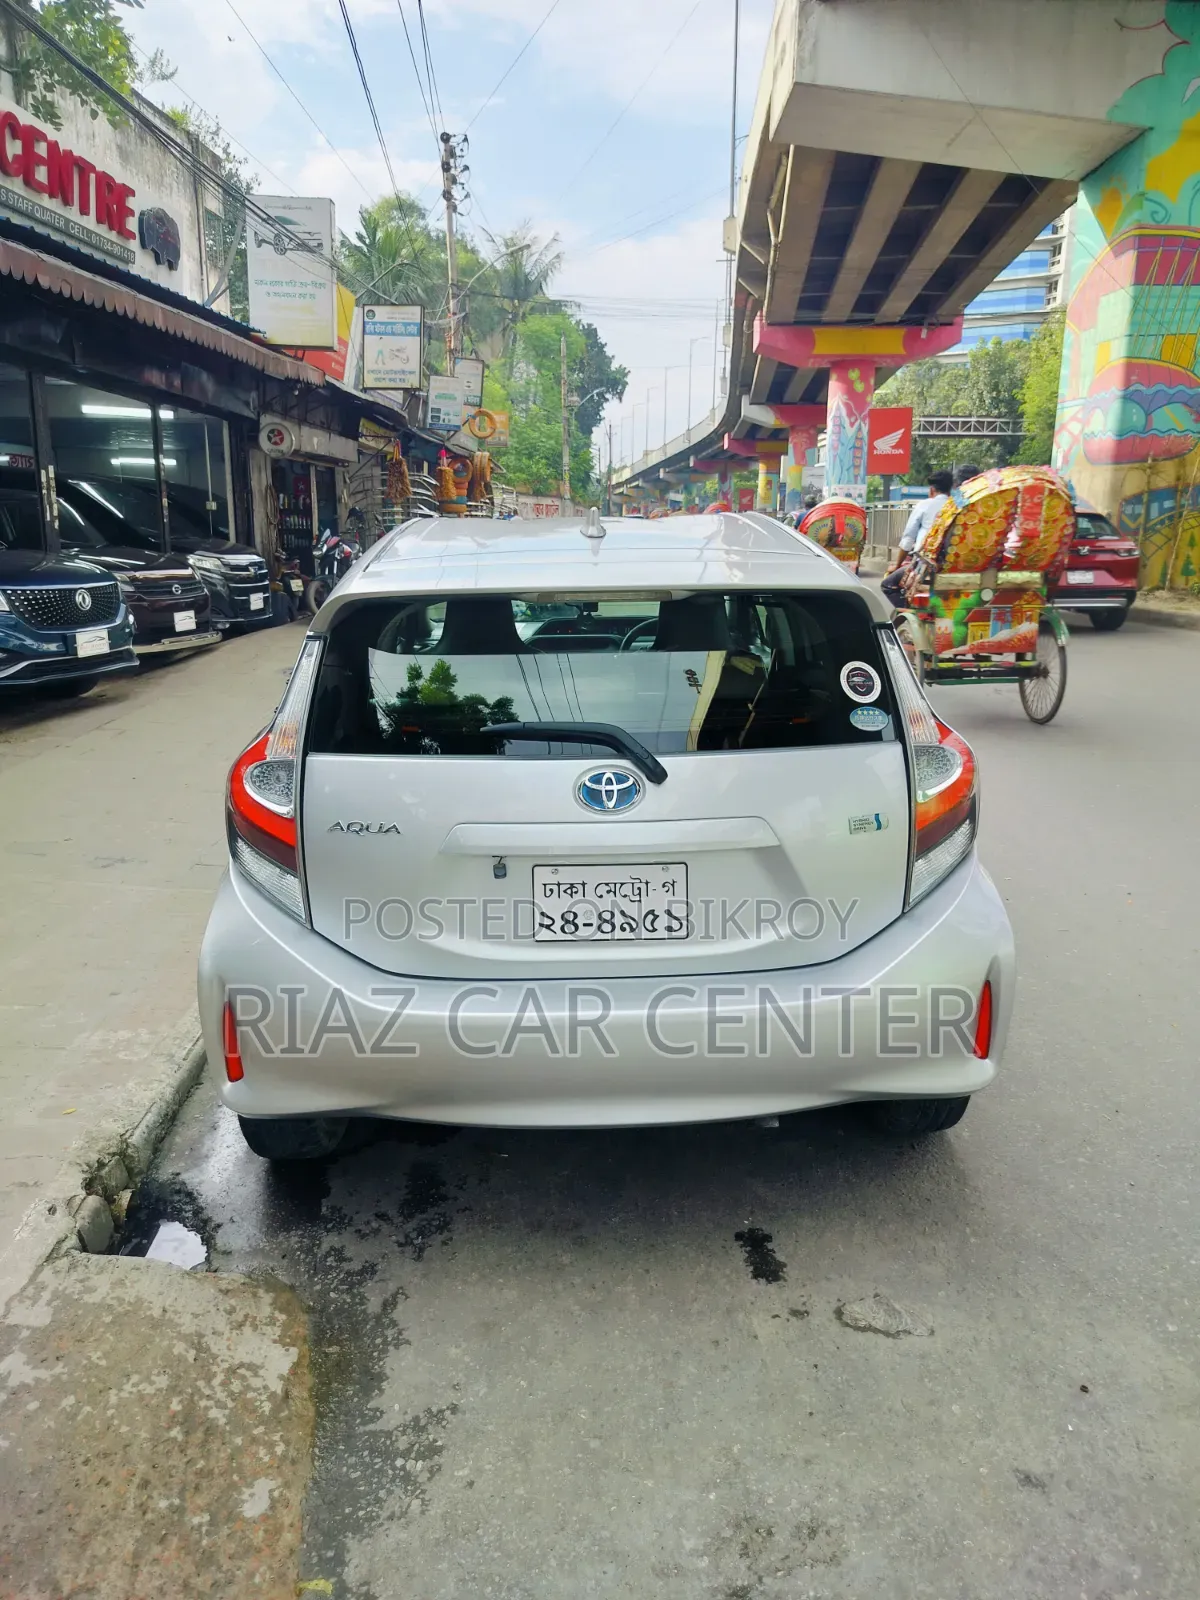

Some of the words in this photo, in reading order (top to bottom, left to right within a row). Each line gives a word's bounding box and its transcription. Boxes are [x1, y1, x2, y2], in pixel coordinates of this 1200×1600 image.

[0, 110, 137, 241] CENTRE
[8, 191, 33, 213] STAFF
[34, 205, 65, 230] QUATER
[69, 222, 91, 242] CELL:
[91, 232, 135, 262] 01734-901418
[327, 819, 402, 836] AQUA
[542, 880, 587, 899] ঢাকা
[538, 909, 683, 934] ২৪-৪৯৫১
